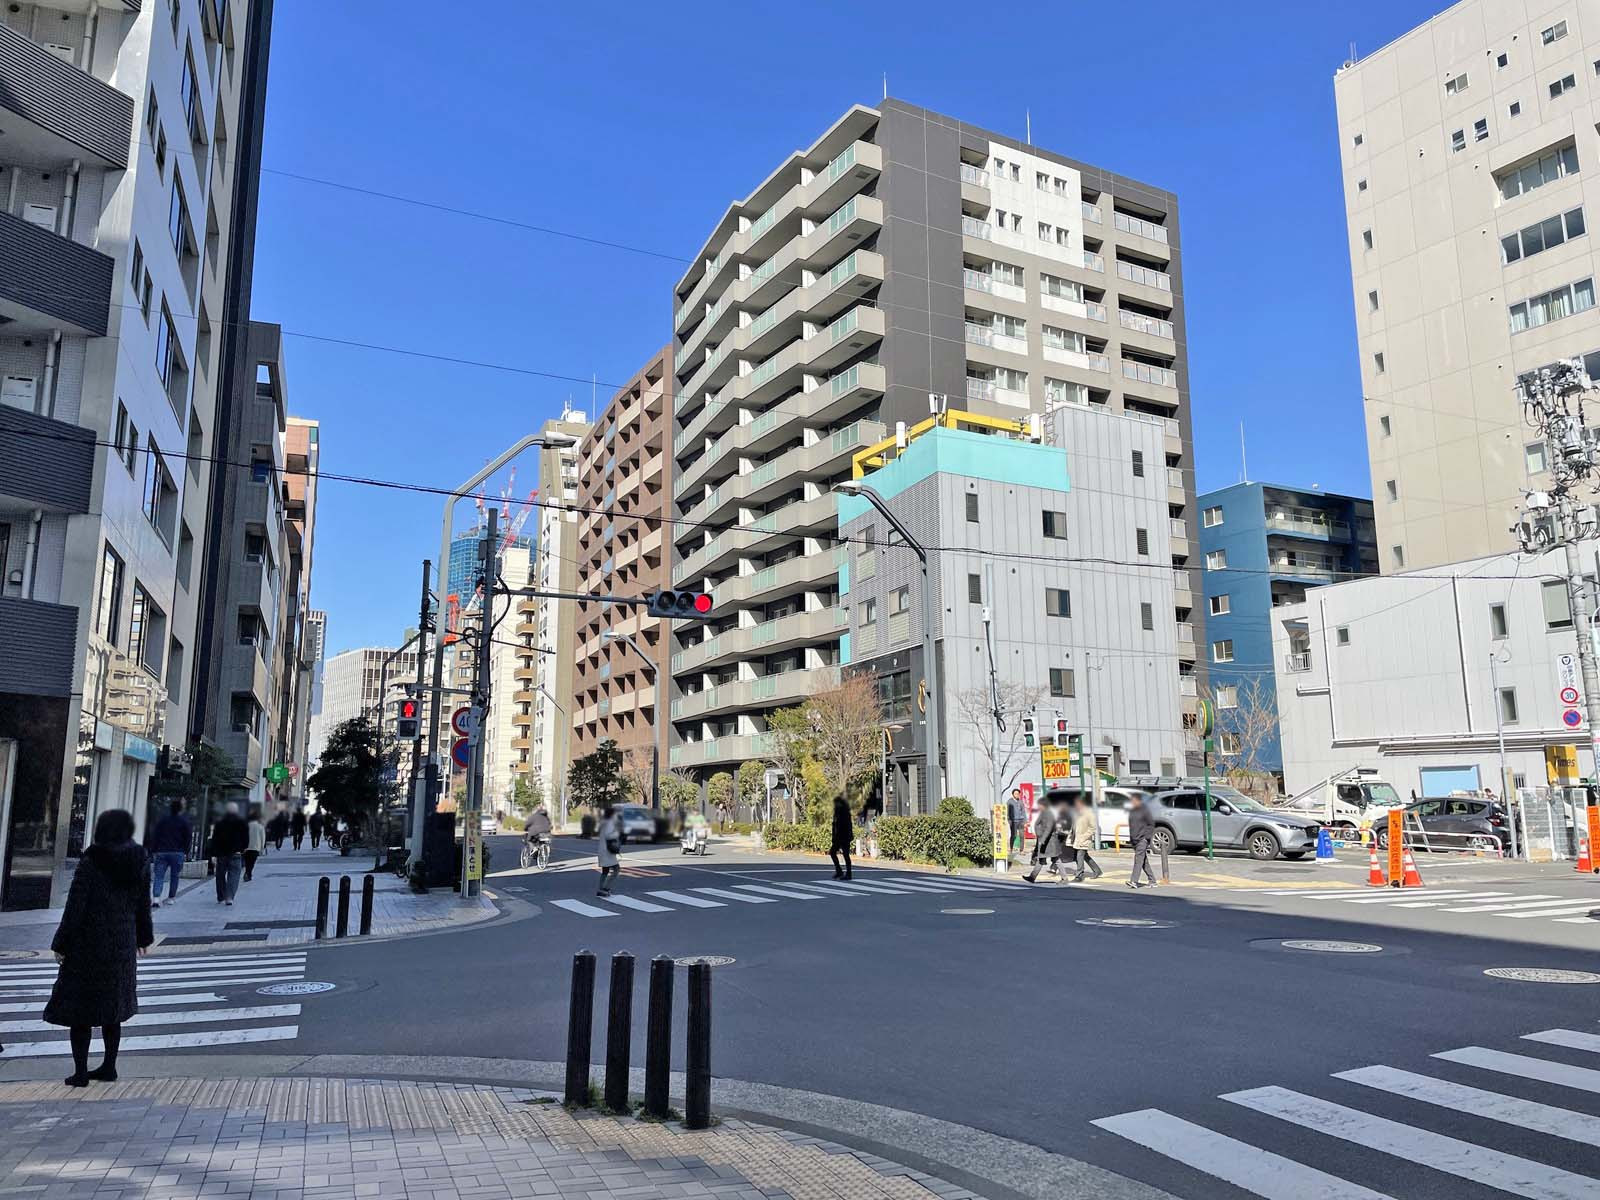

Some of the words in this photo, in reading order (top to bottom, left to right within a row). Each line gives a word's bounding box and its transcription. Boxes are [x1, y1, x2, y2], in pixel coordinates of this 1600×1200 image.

[1564, 692, 1574, 700] 30
[1553, 756, 1576, 768] Times
[1045, 763, 1067, 777] 2300
